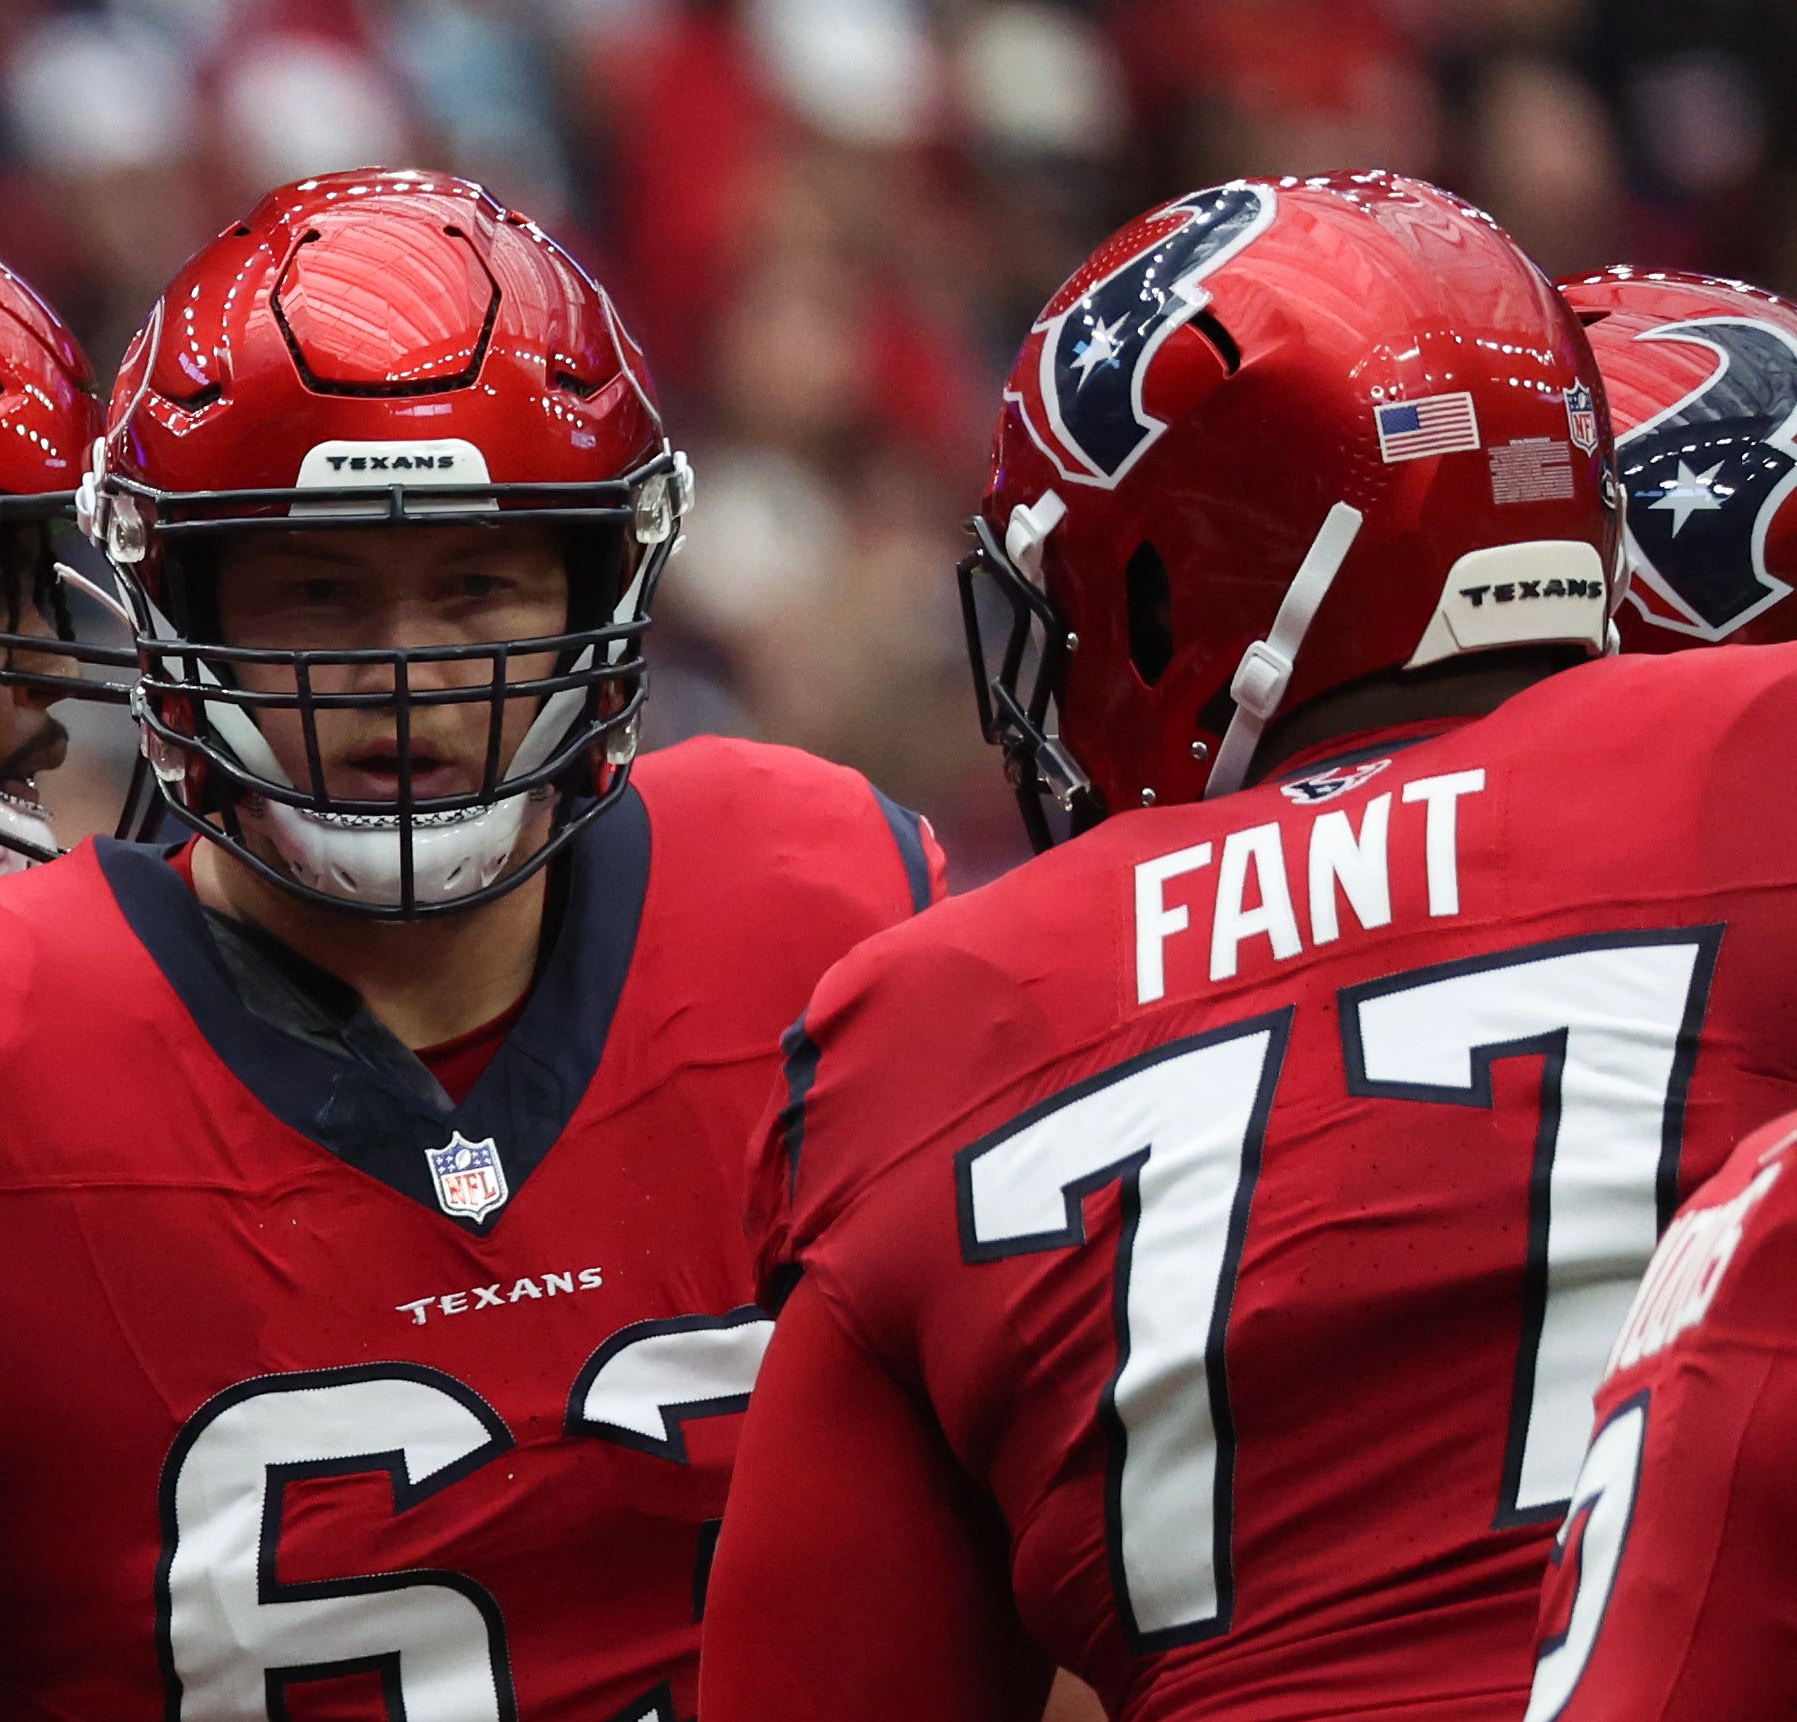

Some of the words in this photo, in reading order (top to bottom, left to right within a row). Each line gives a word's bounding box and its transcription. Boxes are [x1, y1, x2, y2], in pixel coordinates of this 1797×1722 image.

[326, 456, 455, 471] TEXANS
[1459, 579, 1603, 607] TEXANS
[1134, 768, 1486, 1006] FANT
[445, 1170, 497, 1206] NFL
[394, 1266, 604, 1326] TEXANS
[955, 922, 1727, 1656] 77
